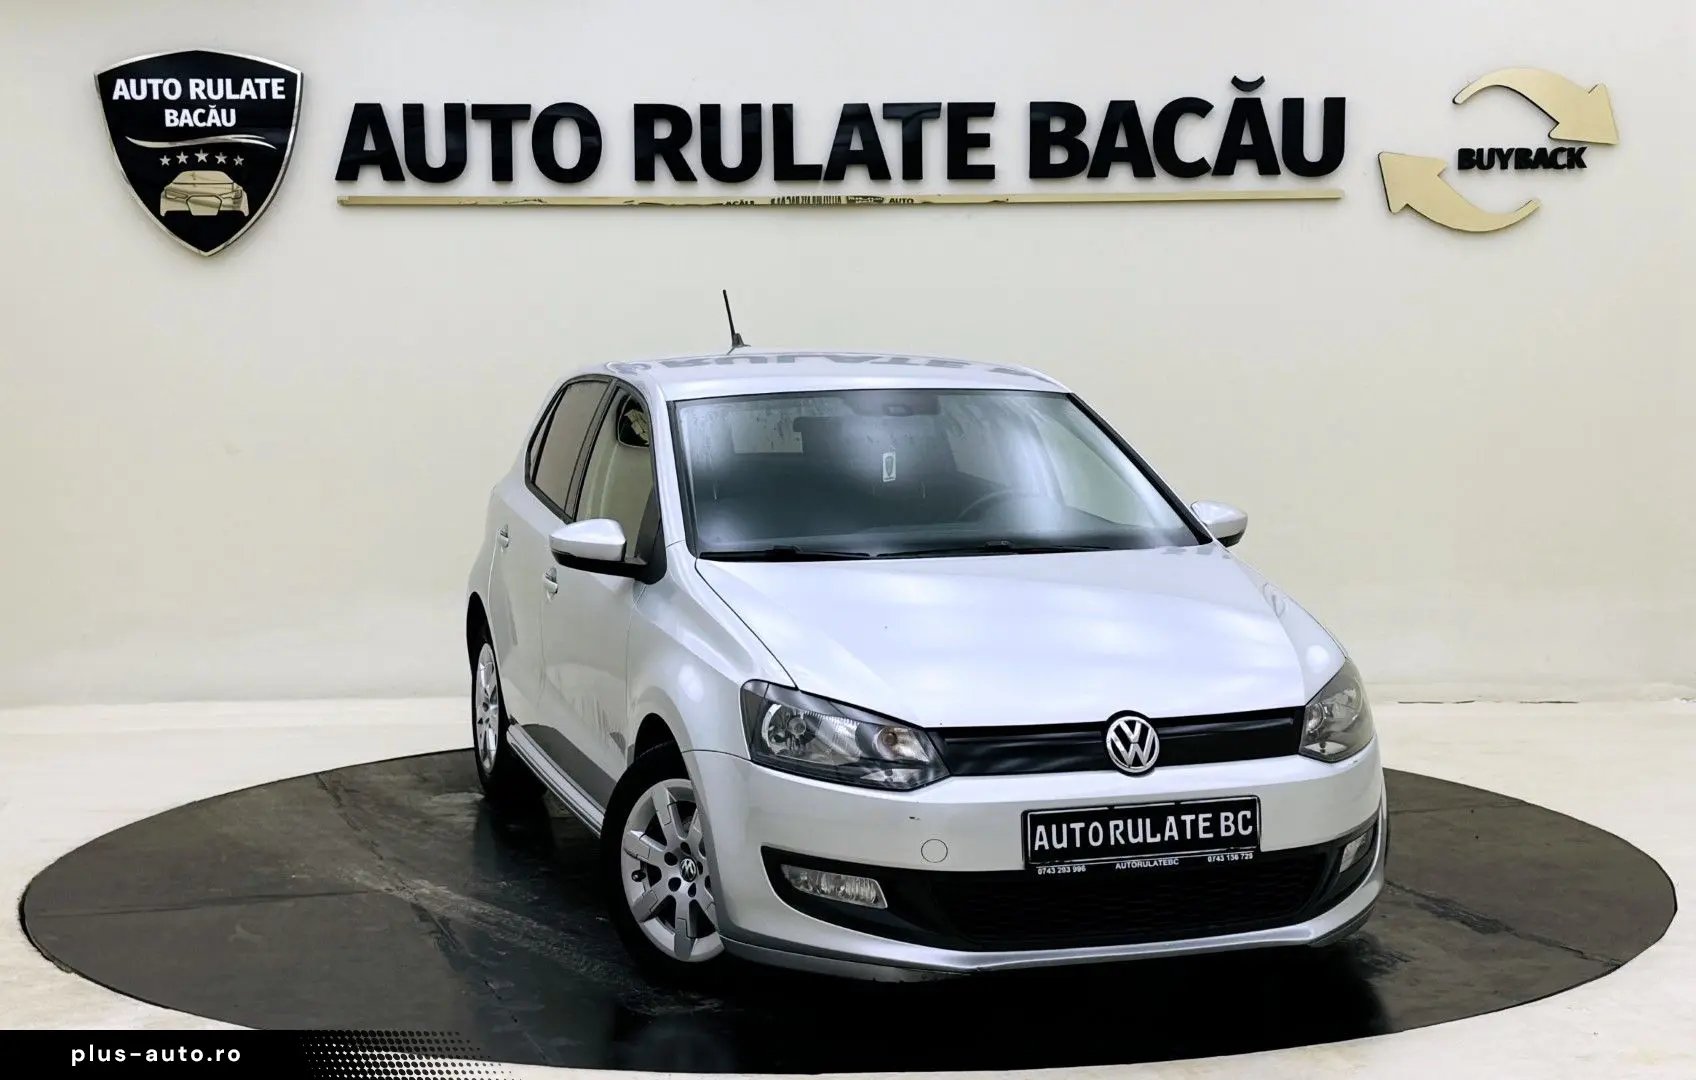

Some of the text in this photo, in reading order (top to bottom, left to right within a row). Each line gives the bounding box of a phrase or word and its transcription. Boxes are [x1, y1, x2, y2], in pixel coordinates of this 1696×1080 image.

[113, 78, 285, 100] AUTO RULATE
[164, 104, 236, 127] BACĂU
[335, 75, 1345, 184] AUTO RULATE BACĂU
[1457, 146, 1587, 170] BUYBACK
[1034, 810, 1253, 851] AUTO RULATE BC
[1115, 858, 1179, 869] AUTORULATEBC
